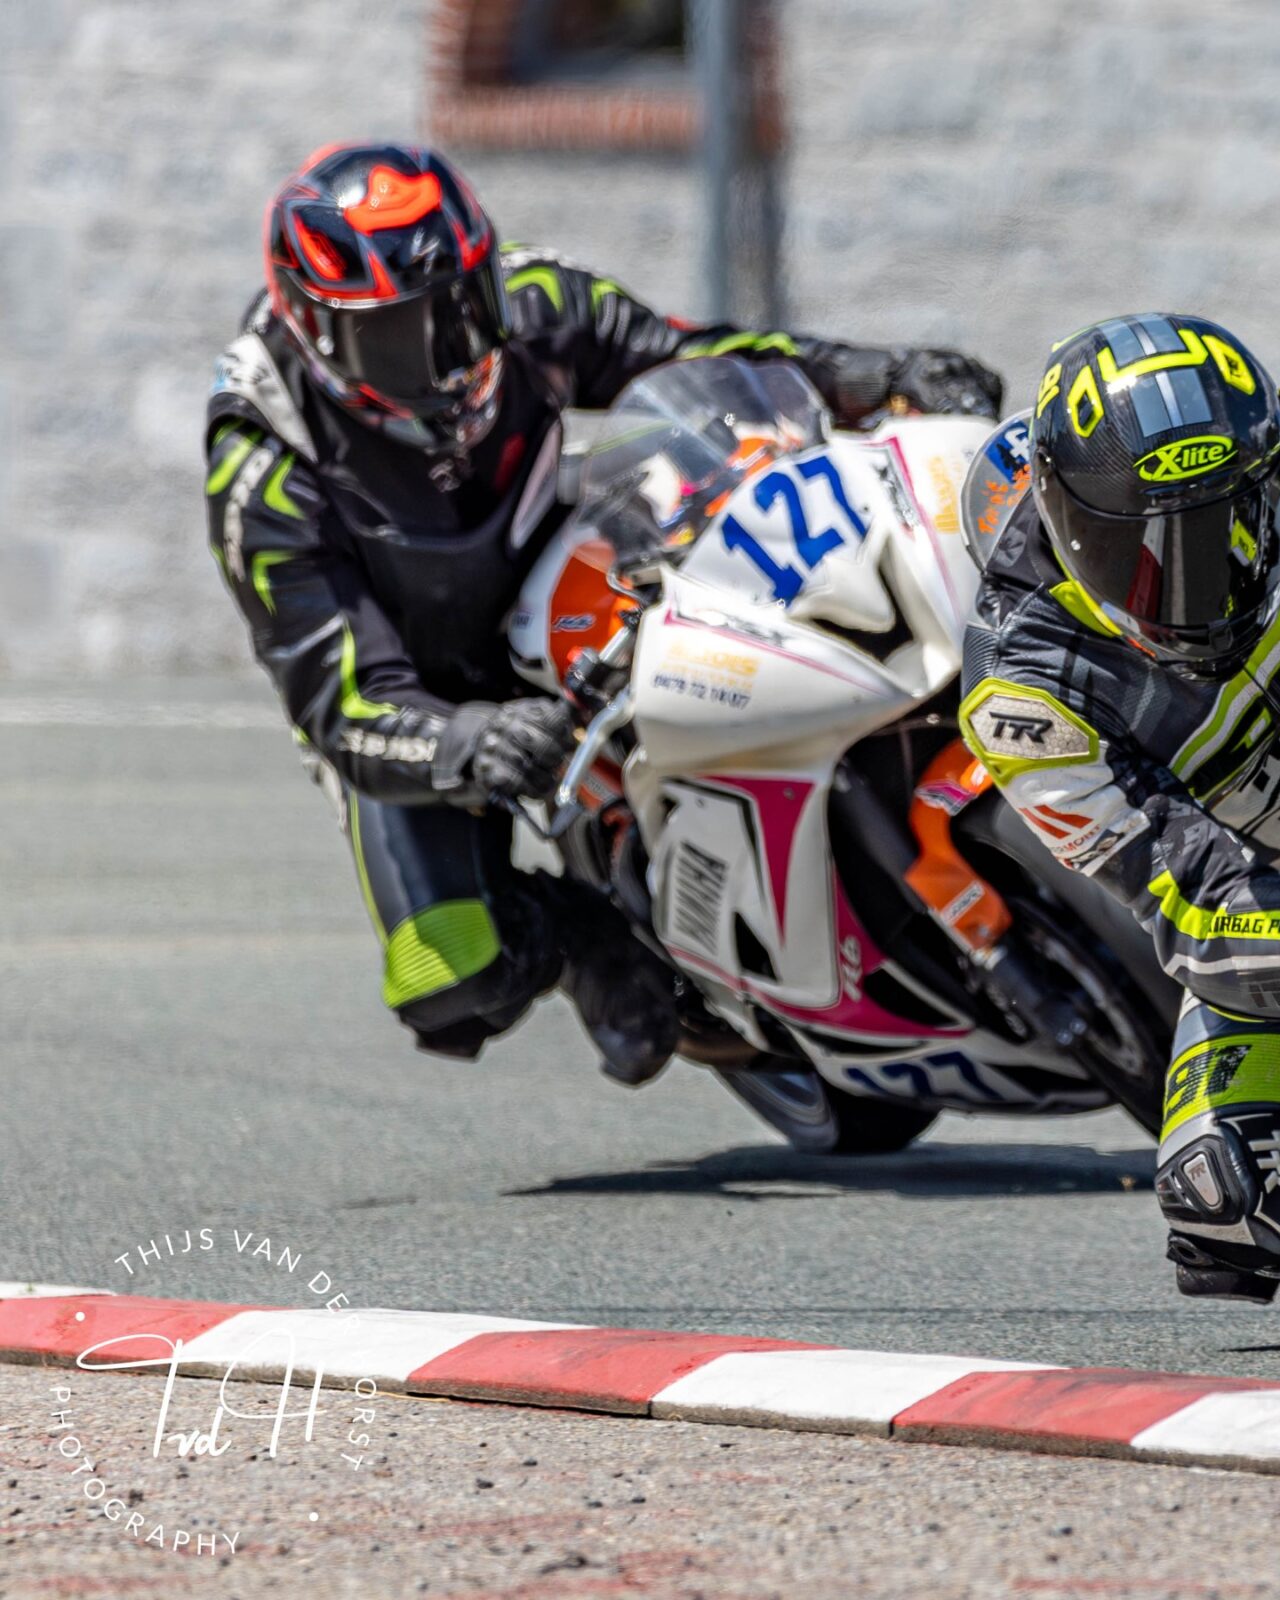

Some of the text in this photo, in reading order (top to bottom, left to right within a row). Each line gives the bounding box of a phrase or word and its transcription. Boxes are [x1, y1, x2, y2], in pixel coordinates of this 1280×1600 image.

[1151, 443, 1224, 480] X-lite
[720, 454, 869, 611] 127
[844, 1051, 1004, 1100] 127
